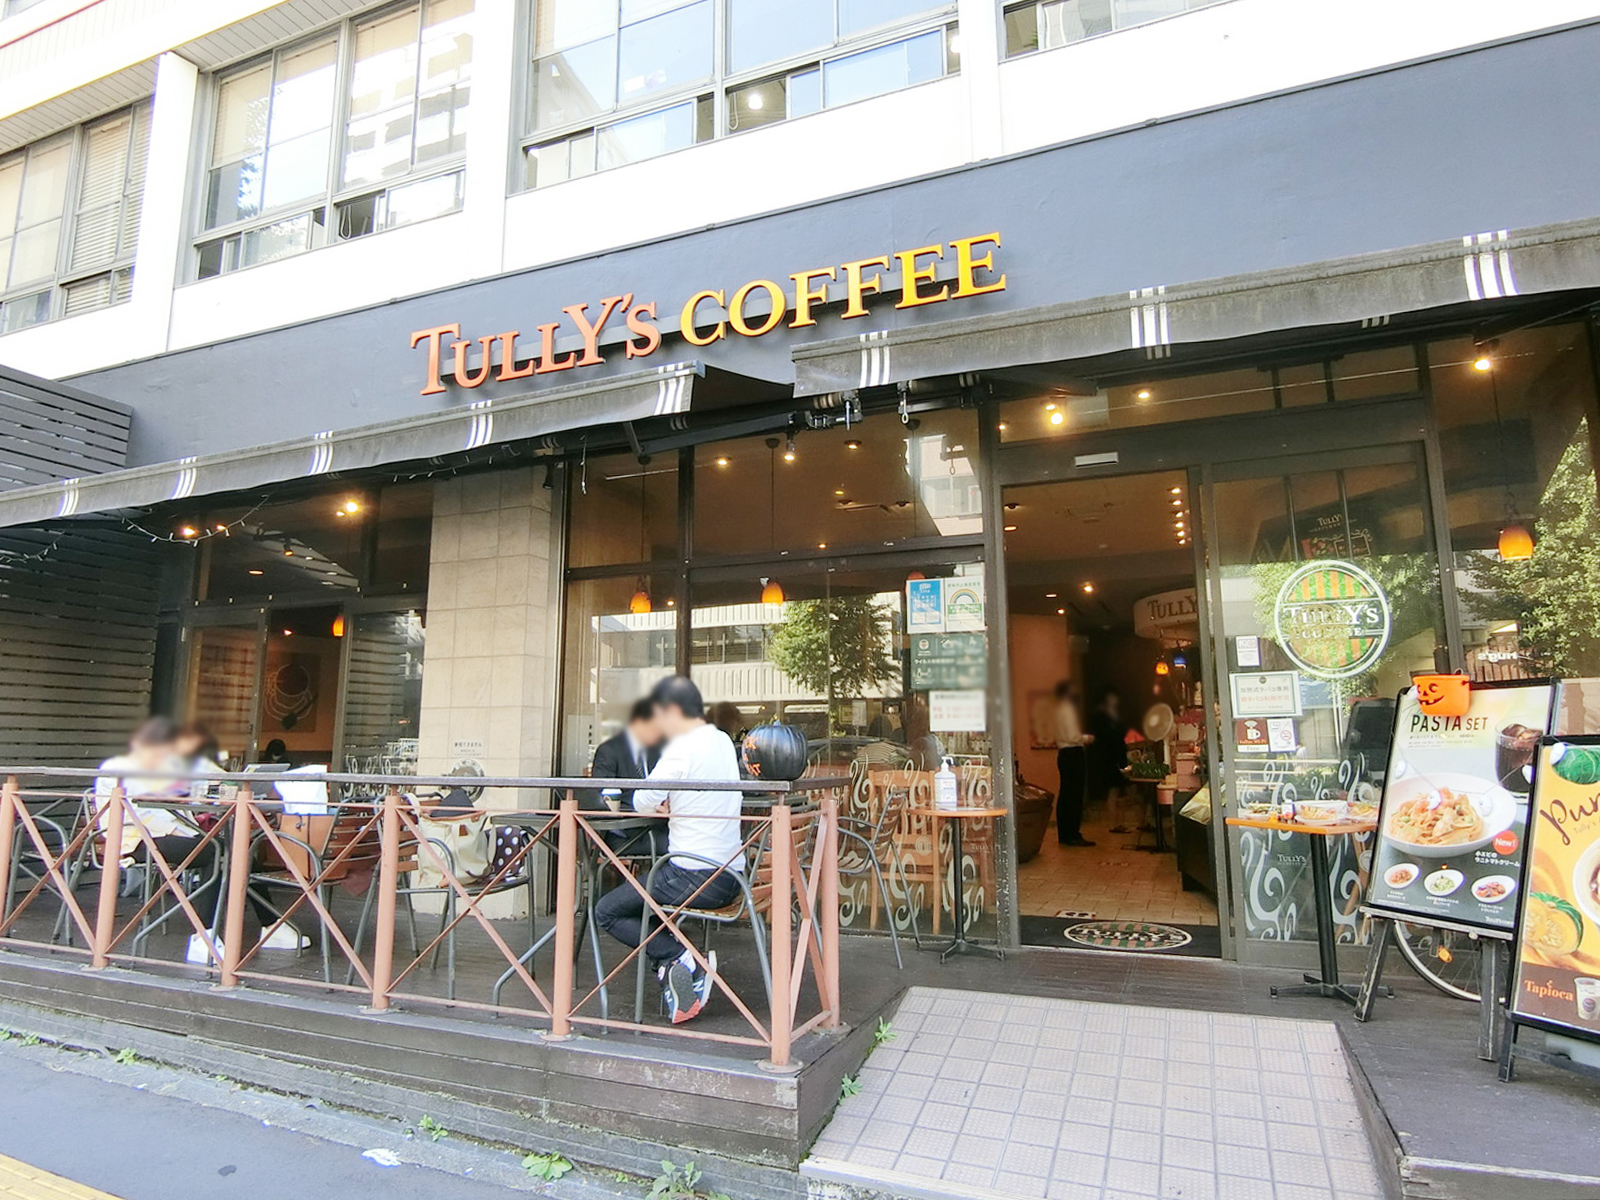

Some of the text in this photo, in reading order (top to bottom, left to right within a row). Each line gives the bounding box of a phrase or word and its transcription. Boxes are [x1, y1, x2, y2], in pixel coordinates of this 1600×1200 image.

[410, 231, 1008, 396] TULLY'S COFFEE
[1466, 716, 1489, 731] SET
[692, 979, 705, 992] N
[1524, 979, 1574, 1001] Tapioca
[664, 989, 673, 1003] N
